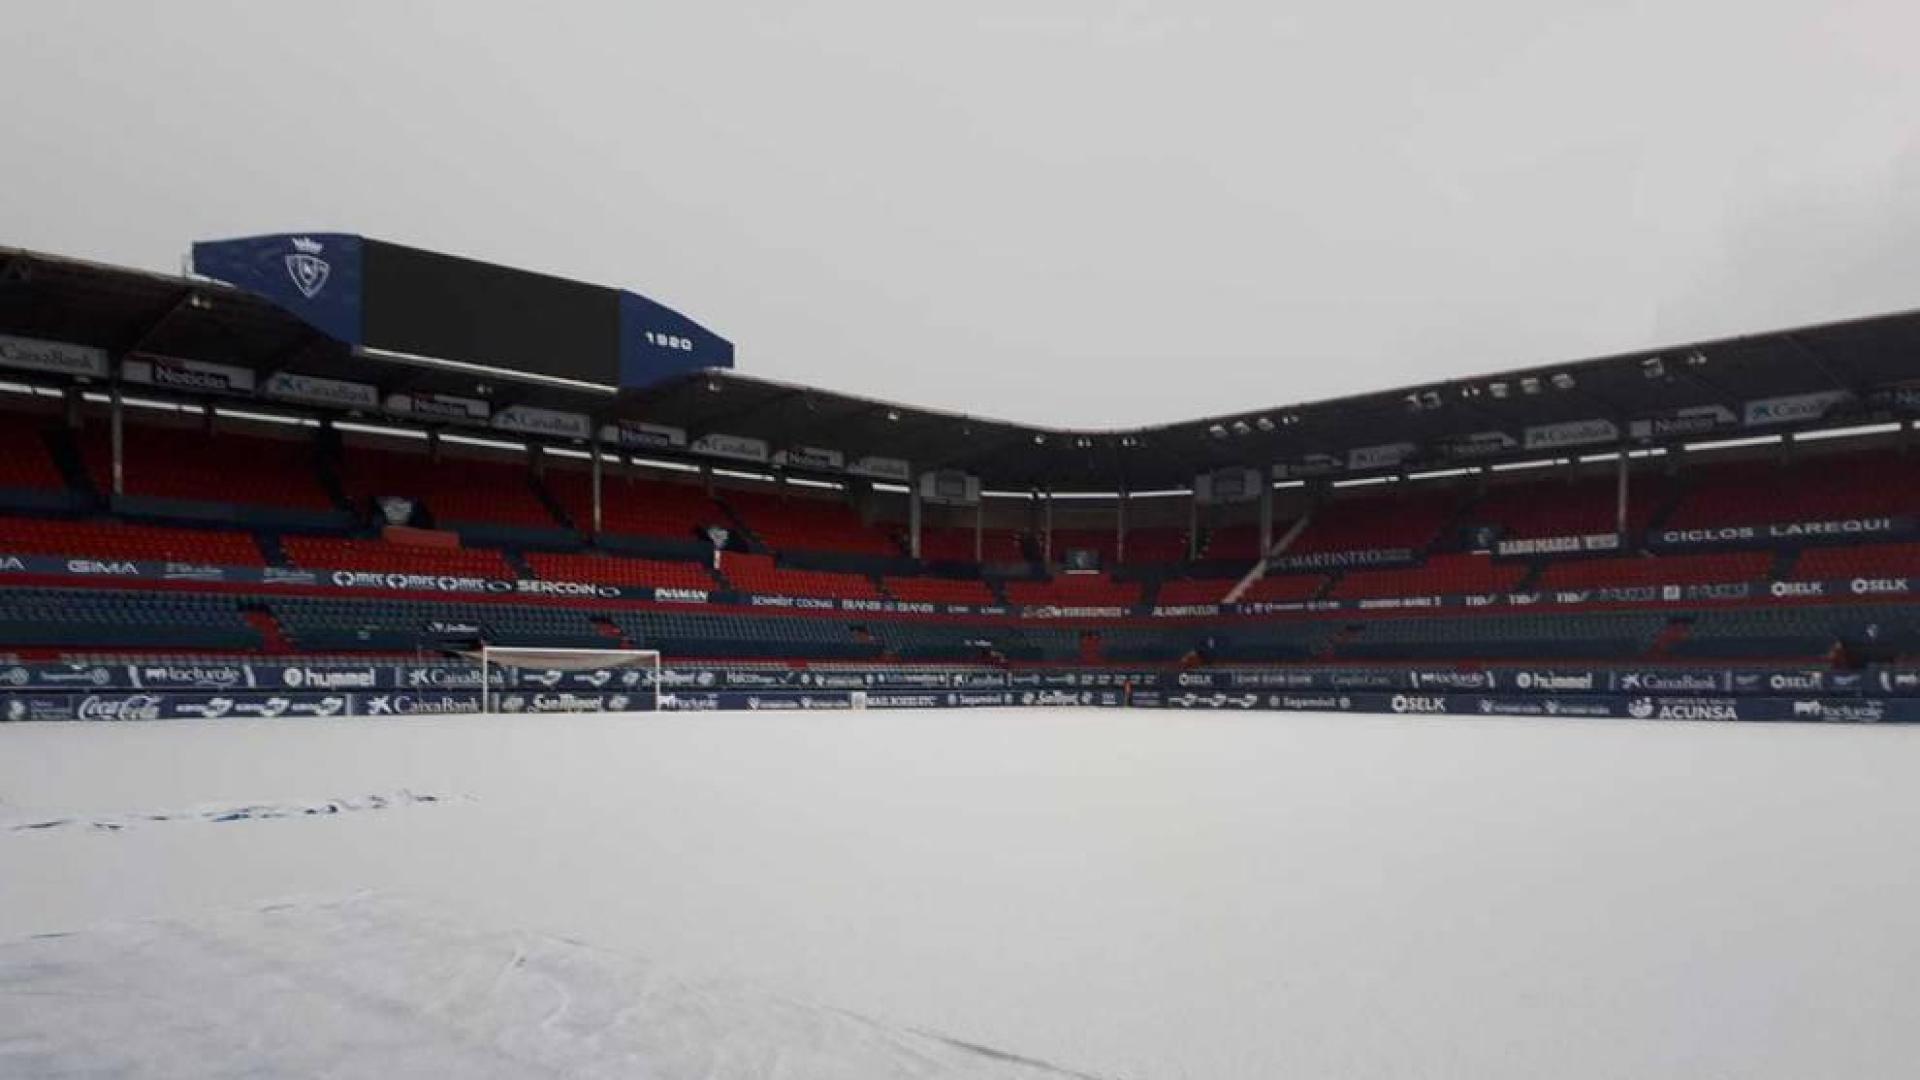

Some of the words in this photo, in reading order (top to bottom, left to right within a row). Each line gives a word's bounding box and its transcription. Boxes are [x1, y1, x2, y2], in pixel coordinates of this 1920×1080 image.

[645, 331, 693, 351] 1920
[155, 366, 226, 388] Noticias
[1664, 527, 1754, 543] CICLOS
[1769, 519, 1892, 538] LAREQUI
[67, 559, 139, 575] GIMA
[305, 667, 376, 688] hummel
[429, 669, 504, 684] CaixaBnk
[1533, 672, 1593, 688] hummel
[393, 696, 480, 713] CaixaBank
[1407, 697, 1446, 711] SELK
[1659, 706, 1739, 720] ACUNSA
